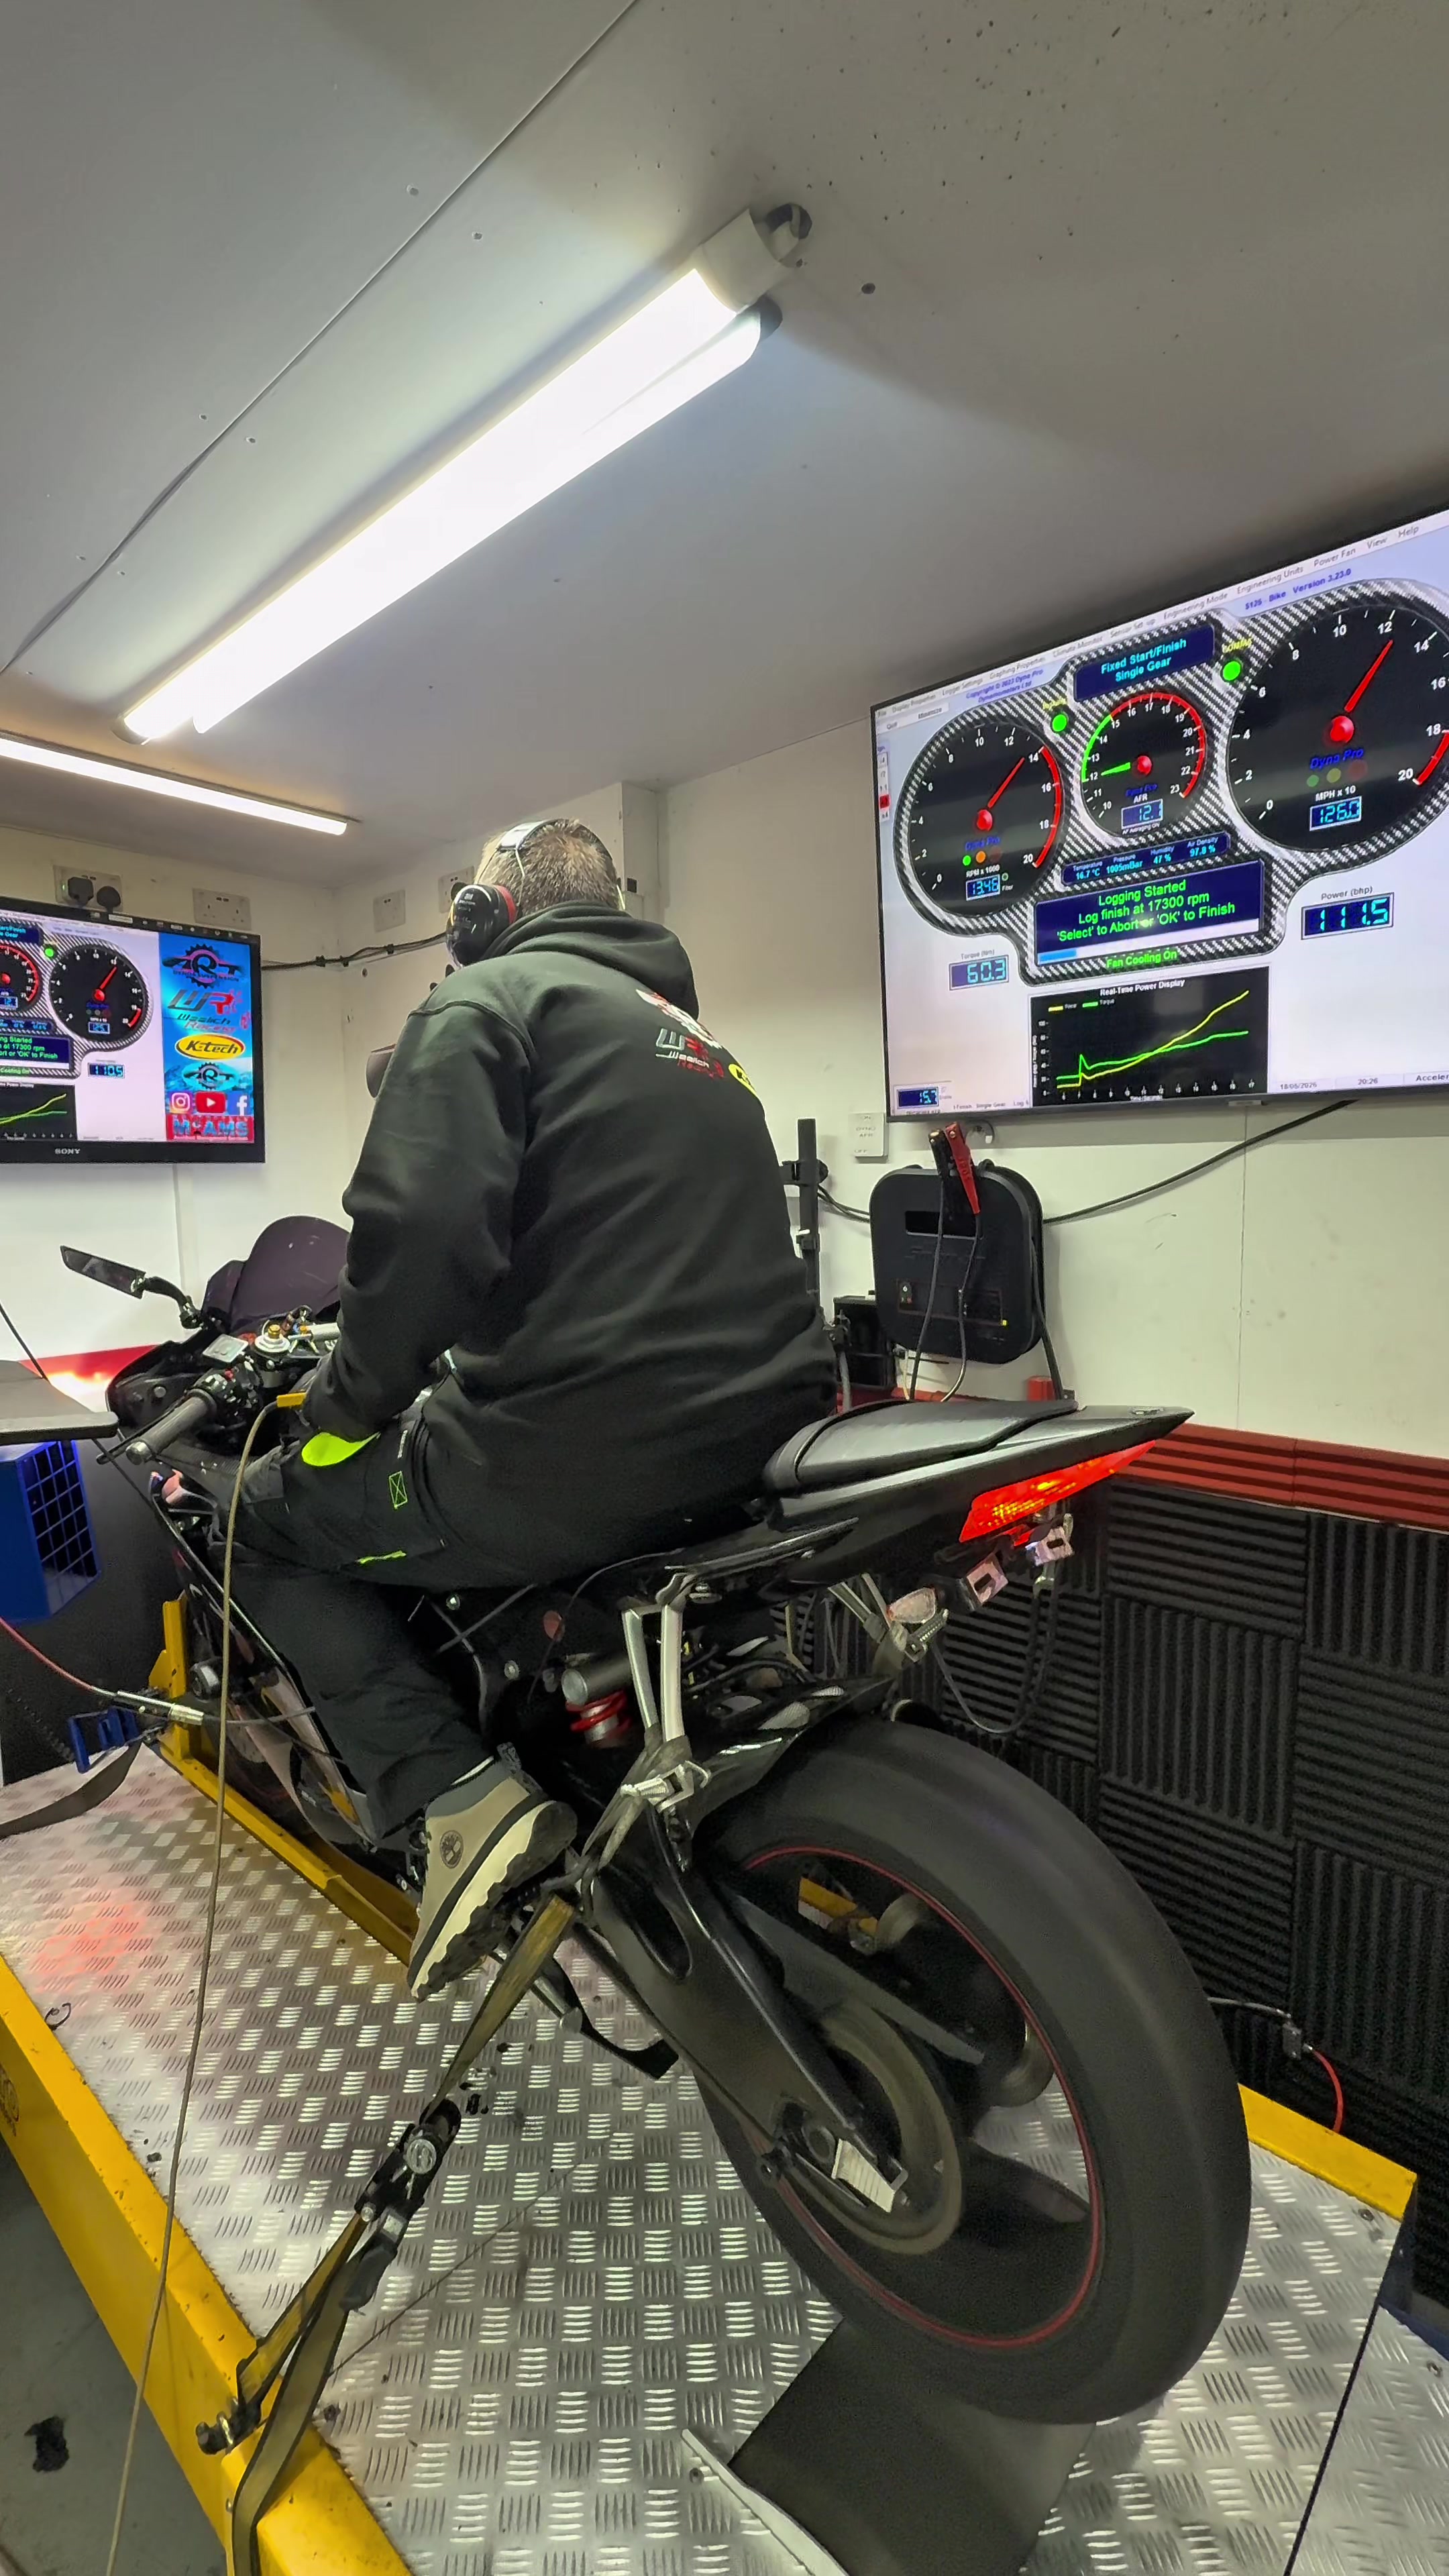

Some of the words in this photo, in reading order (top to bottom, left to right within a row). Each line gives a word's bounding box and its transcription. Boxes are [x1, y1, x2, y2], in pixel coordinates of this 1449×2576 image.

[1398, 526, 1419, 539] Help
[1366, 537, 1388, 549] View
[1313, 553, 1340, 567] Power
[1341, 547, 1356, 559] Fan
[1237, 573, 1282, 594] Engineering
[1284, 566, 1304, 578] Units
[1269, 590, 1287, 603] Bike
[1293, 578, 1326, 594] Version
[1164, 600, 1205, 619] Engineering
[1207, 592, 1228, 605] Mode
[1333, 625, 1347, 637] 10
[1377, 621, 1392, 635] 12
[1413, 639, 1429, 653] 14
[1101, 657, 1127, 674] Fixed
[1130, 638, 1187, 665] Start/Finish
[1292, 650, 1299, 661] 8
[1116, 666, 1144, 682] Single
[1147, 657, 1172, 672] Gear
[1430, 677, 1446, 690] 16
[1258, 686, 1266, 698] 6
[1127, 708, 1136, 717] 16
[1145, 702, 1153, 712] 17
[1161, 705, 1171, 714] 18
[1111, 719, 1120, 729] 15
[1175, 714, 1185, 723] 19
[1183, 727, 1193, 737] 20
[1243, 729, 1250, 739] 4
[1426, 723, 1441, 737] 18
[975, 737, 984, 747] 10
[1004, 736, 1014, 746] 12
[1099, 735, 1108, 745] 14
[1185, 746, 1195, 755] 21
[1343, 749, 1364, 761] Pro
[949, 754, 954, 763] 8
[1028, 753, 1039, 763] 14
[1091, 753, 1100, 762] 13
[1090, 771, 1098, 781] 12
[1181, 765, 1191, 776] 22
[1246, 769, 1252, 781] 2
[1398, 767, 1413, 782] 20
[928, 784, 933, 792] 6
[1041, 782, 1051, 792] 16
[1170, 784, 1180, 794] 23
[1093, 788, 1102, 798] 11
[1133, 793, 1148, 804] AFR
[1316, 790, 1335, 802] MPH
[1337, 789, 1342, 797] x
[1345, 785, 1356, 795] 10
[1103, 800, 1112, 810] 10
[1267, 799, 1273, 810] 0
[918, 816, 923, 825] 4
[1040, 820, 1049, 829] 18
[922, 849, 927, 857] 2
[1189, 846, 1207, 857] 97.8
[1208, 844, 1216, 853] %
[1023, 853, 1033, 864] 20
[1153, 855, 1163, 864] 47
[936, 873, 942, 882] 0
[1098, 889, 1141, 907] Logging
[1144, 879, 1186, 898] Started
[1321, 890, 1348, 901] Power
[1350, 885, 1373, 897] (bhp)
[1079, 912, 1098, 925] Log
[1101, 906, 1130, 921] finish
[1133, 904, 1144, 915] at
[1148, 897, 1184, 912] 17300
[1187, 893, 1210, 906] rpm
[1320, 898, 1389, 931] 111.5
[1057, 926, 1094, 942] 'Select'
[1097, 925, 1108, 936] to
[1110, 918, 1139, 933] Abort
[1157, 911, 1181, 926] 'OK'
[1183, 910, 1195, 922] to
[1198, 902, 1236, 918] Finish
[1106, 957, 1123, 969] Fan
[1125, 952, 1161, 967] Cooling
[1163, 950, 1177, 960] On
[967, 959, 1006, 983] 60.3
[1100, 986, 1134, 997] Real-Time
[1135, 983, 1157, 993] Power
[1159, 979, 1185, 989] Display
[1358, 1077, 1378, 1085] 20:26
